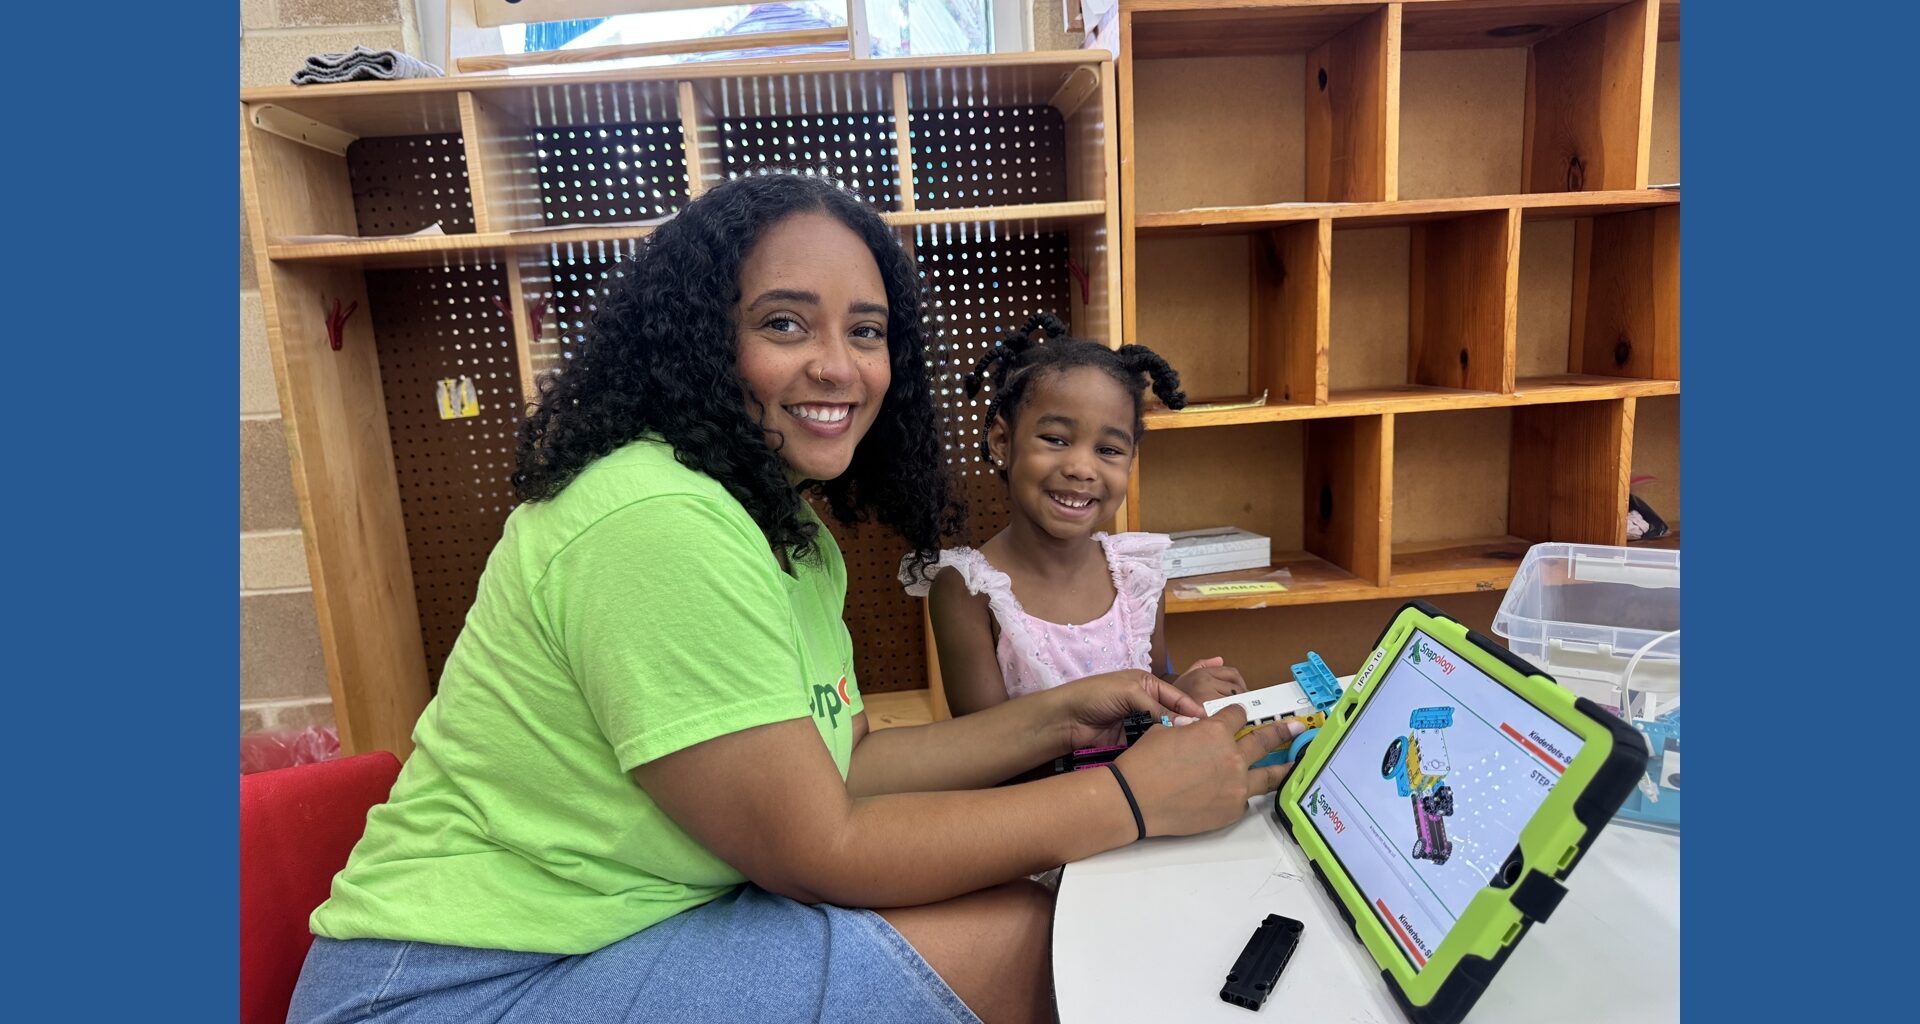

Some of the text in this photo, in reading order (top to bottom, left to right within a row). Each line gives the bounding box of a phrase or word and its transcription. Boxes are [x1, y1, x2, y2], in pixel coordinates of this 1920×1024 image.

[1357, 651, 1383, 687] IPAD 16
[1420, 642, 1456, 675] Snapology
[1530, 769, 1550, 787] STEP
[1318, 794, 1345, 834] Snapology
